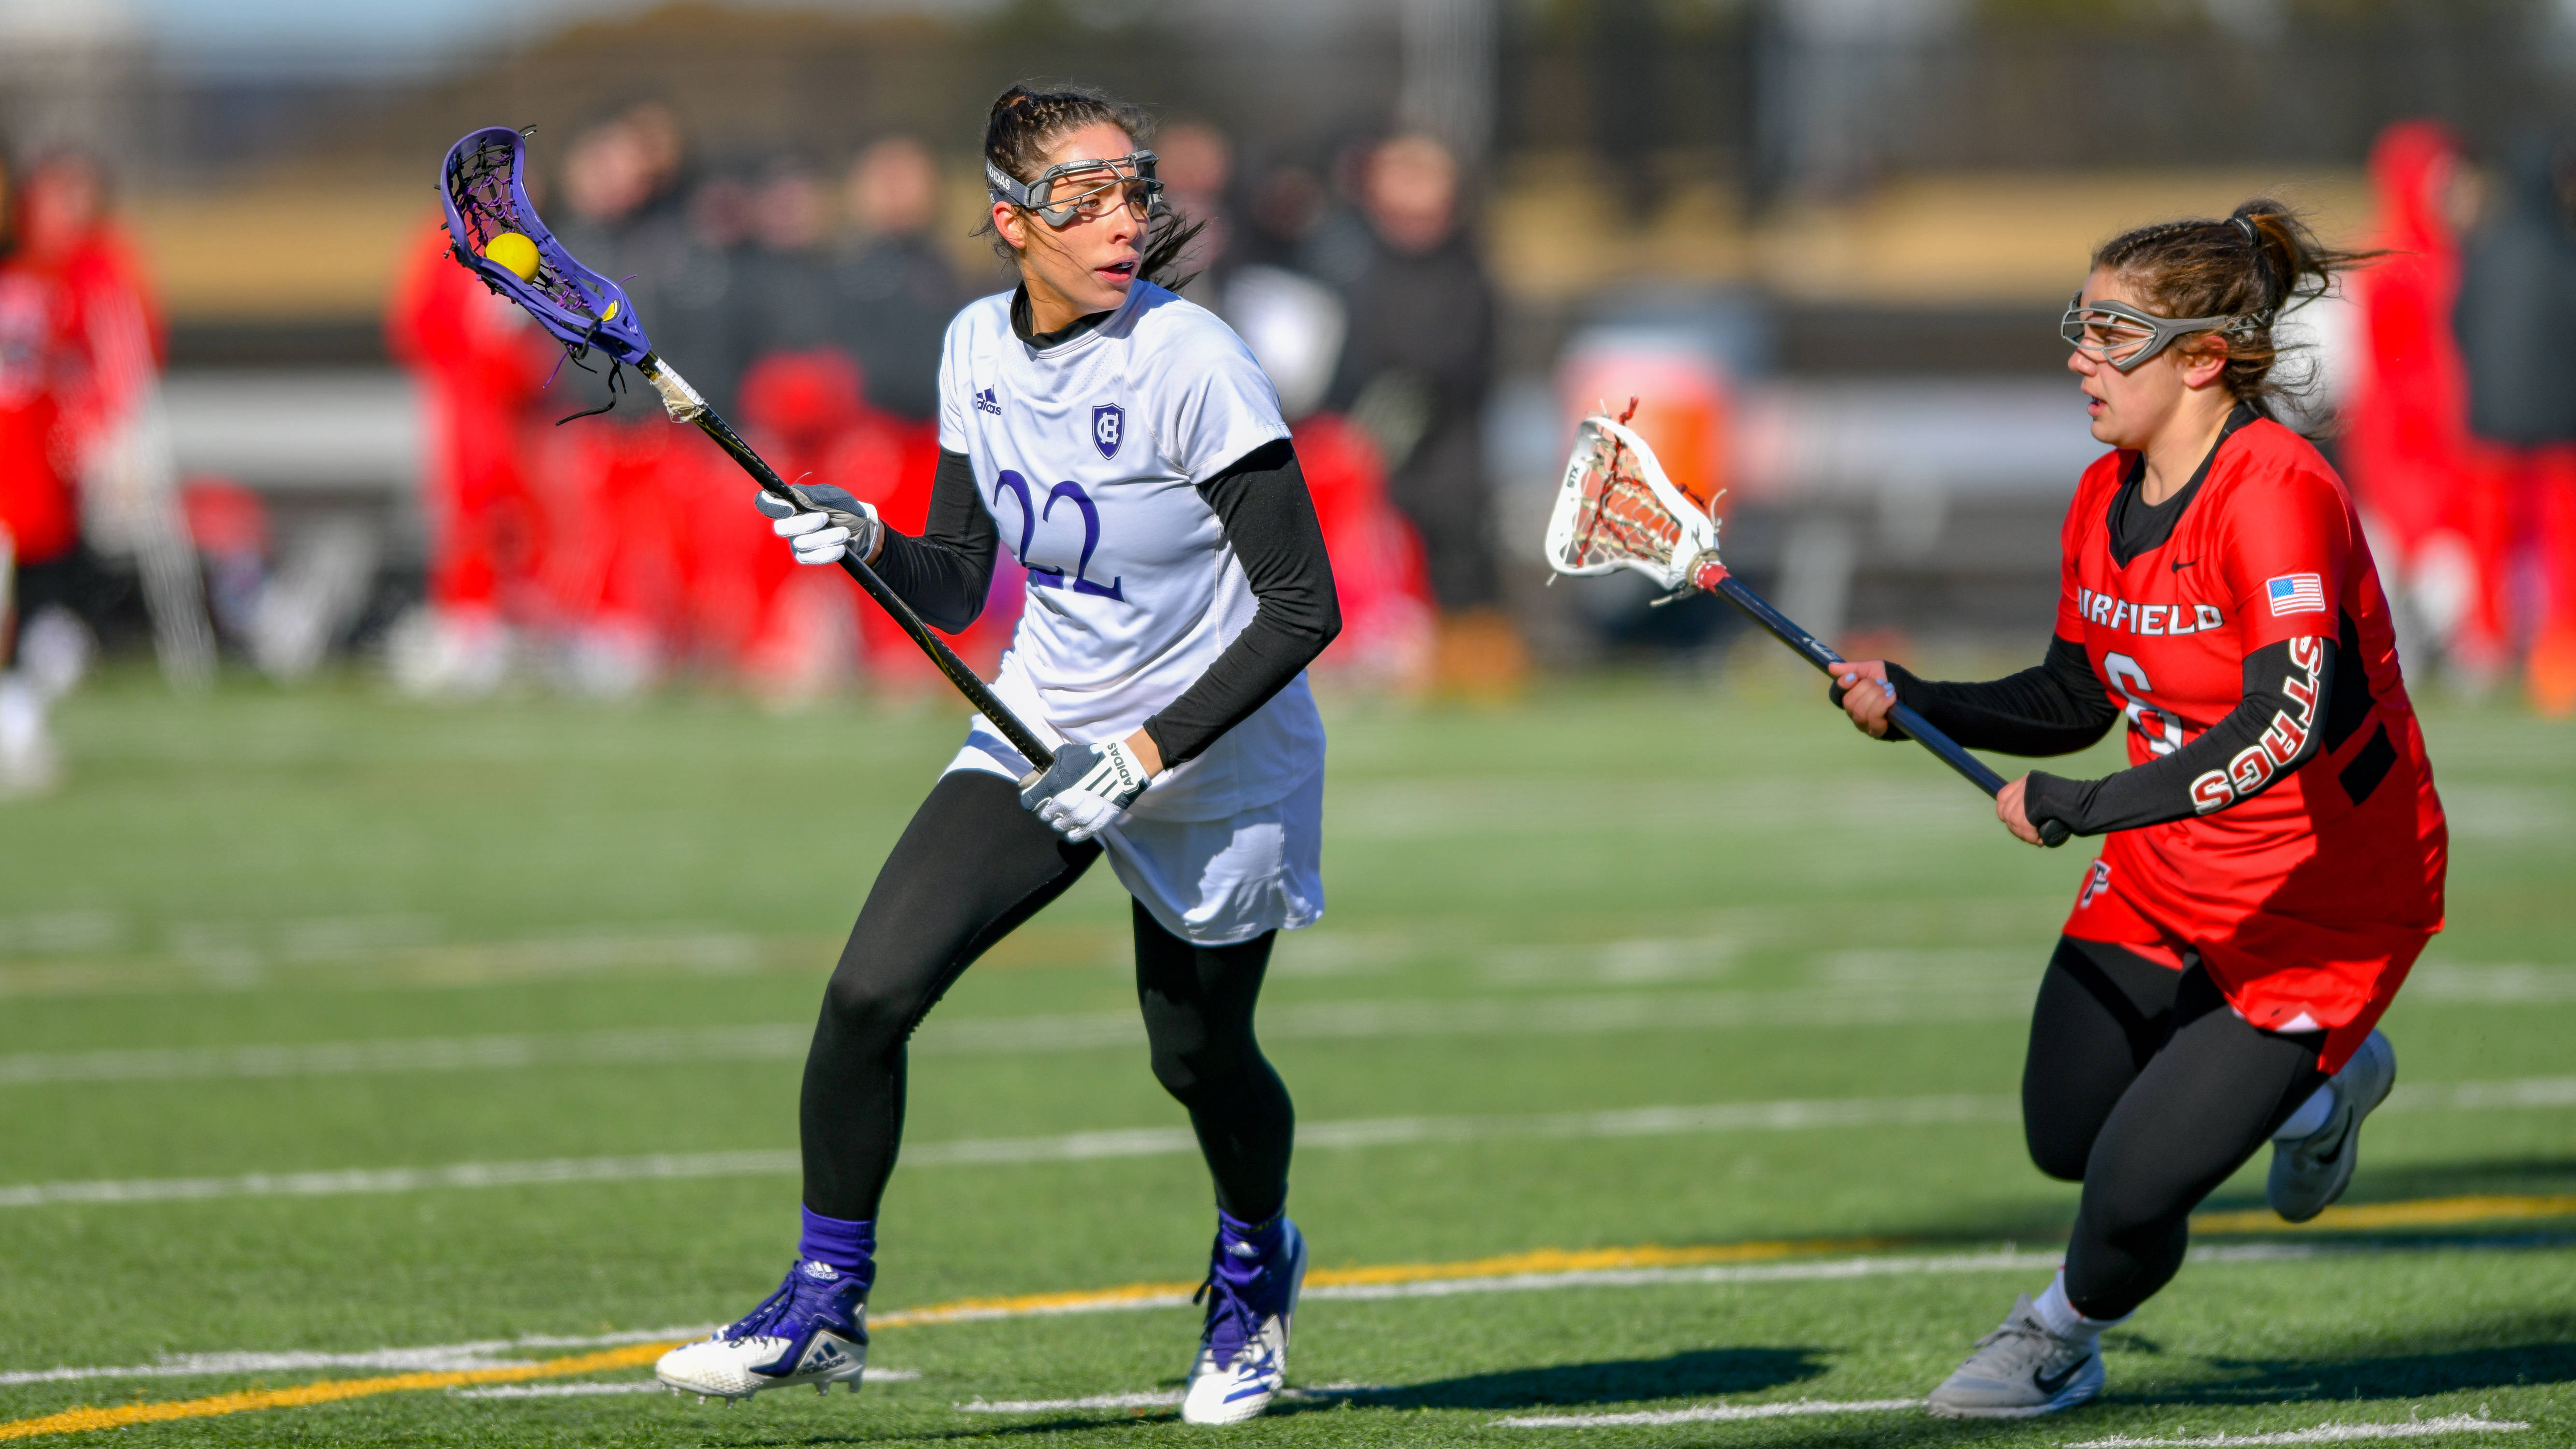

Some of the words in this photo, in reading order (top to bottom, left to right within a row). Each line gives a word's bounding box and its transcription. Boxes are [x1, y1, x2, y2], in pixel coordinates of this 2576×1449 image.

[988, 162, 1010, 190] ADIDAS
[1567, 465, 1580, 488] STX
[993, 469, 1125, 603] 22
[2078, 585, 2223, 635] IRFIELD
[2104, 650, 2183, 757] 6
[2189, 636, 2323, 815] STAGS
[1108, 743, 1134, 785] ADIDAS
